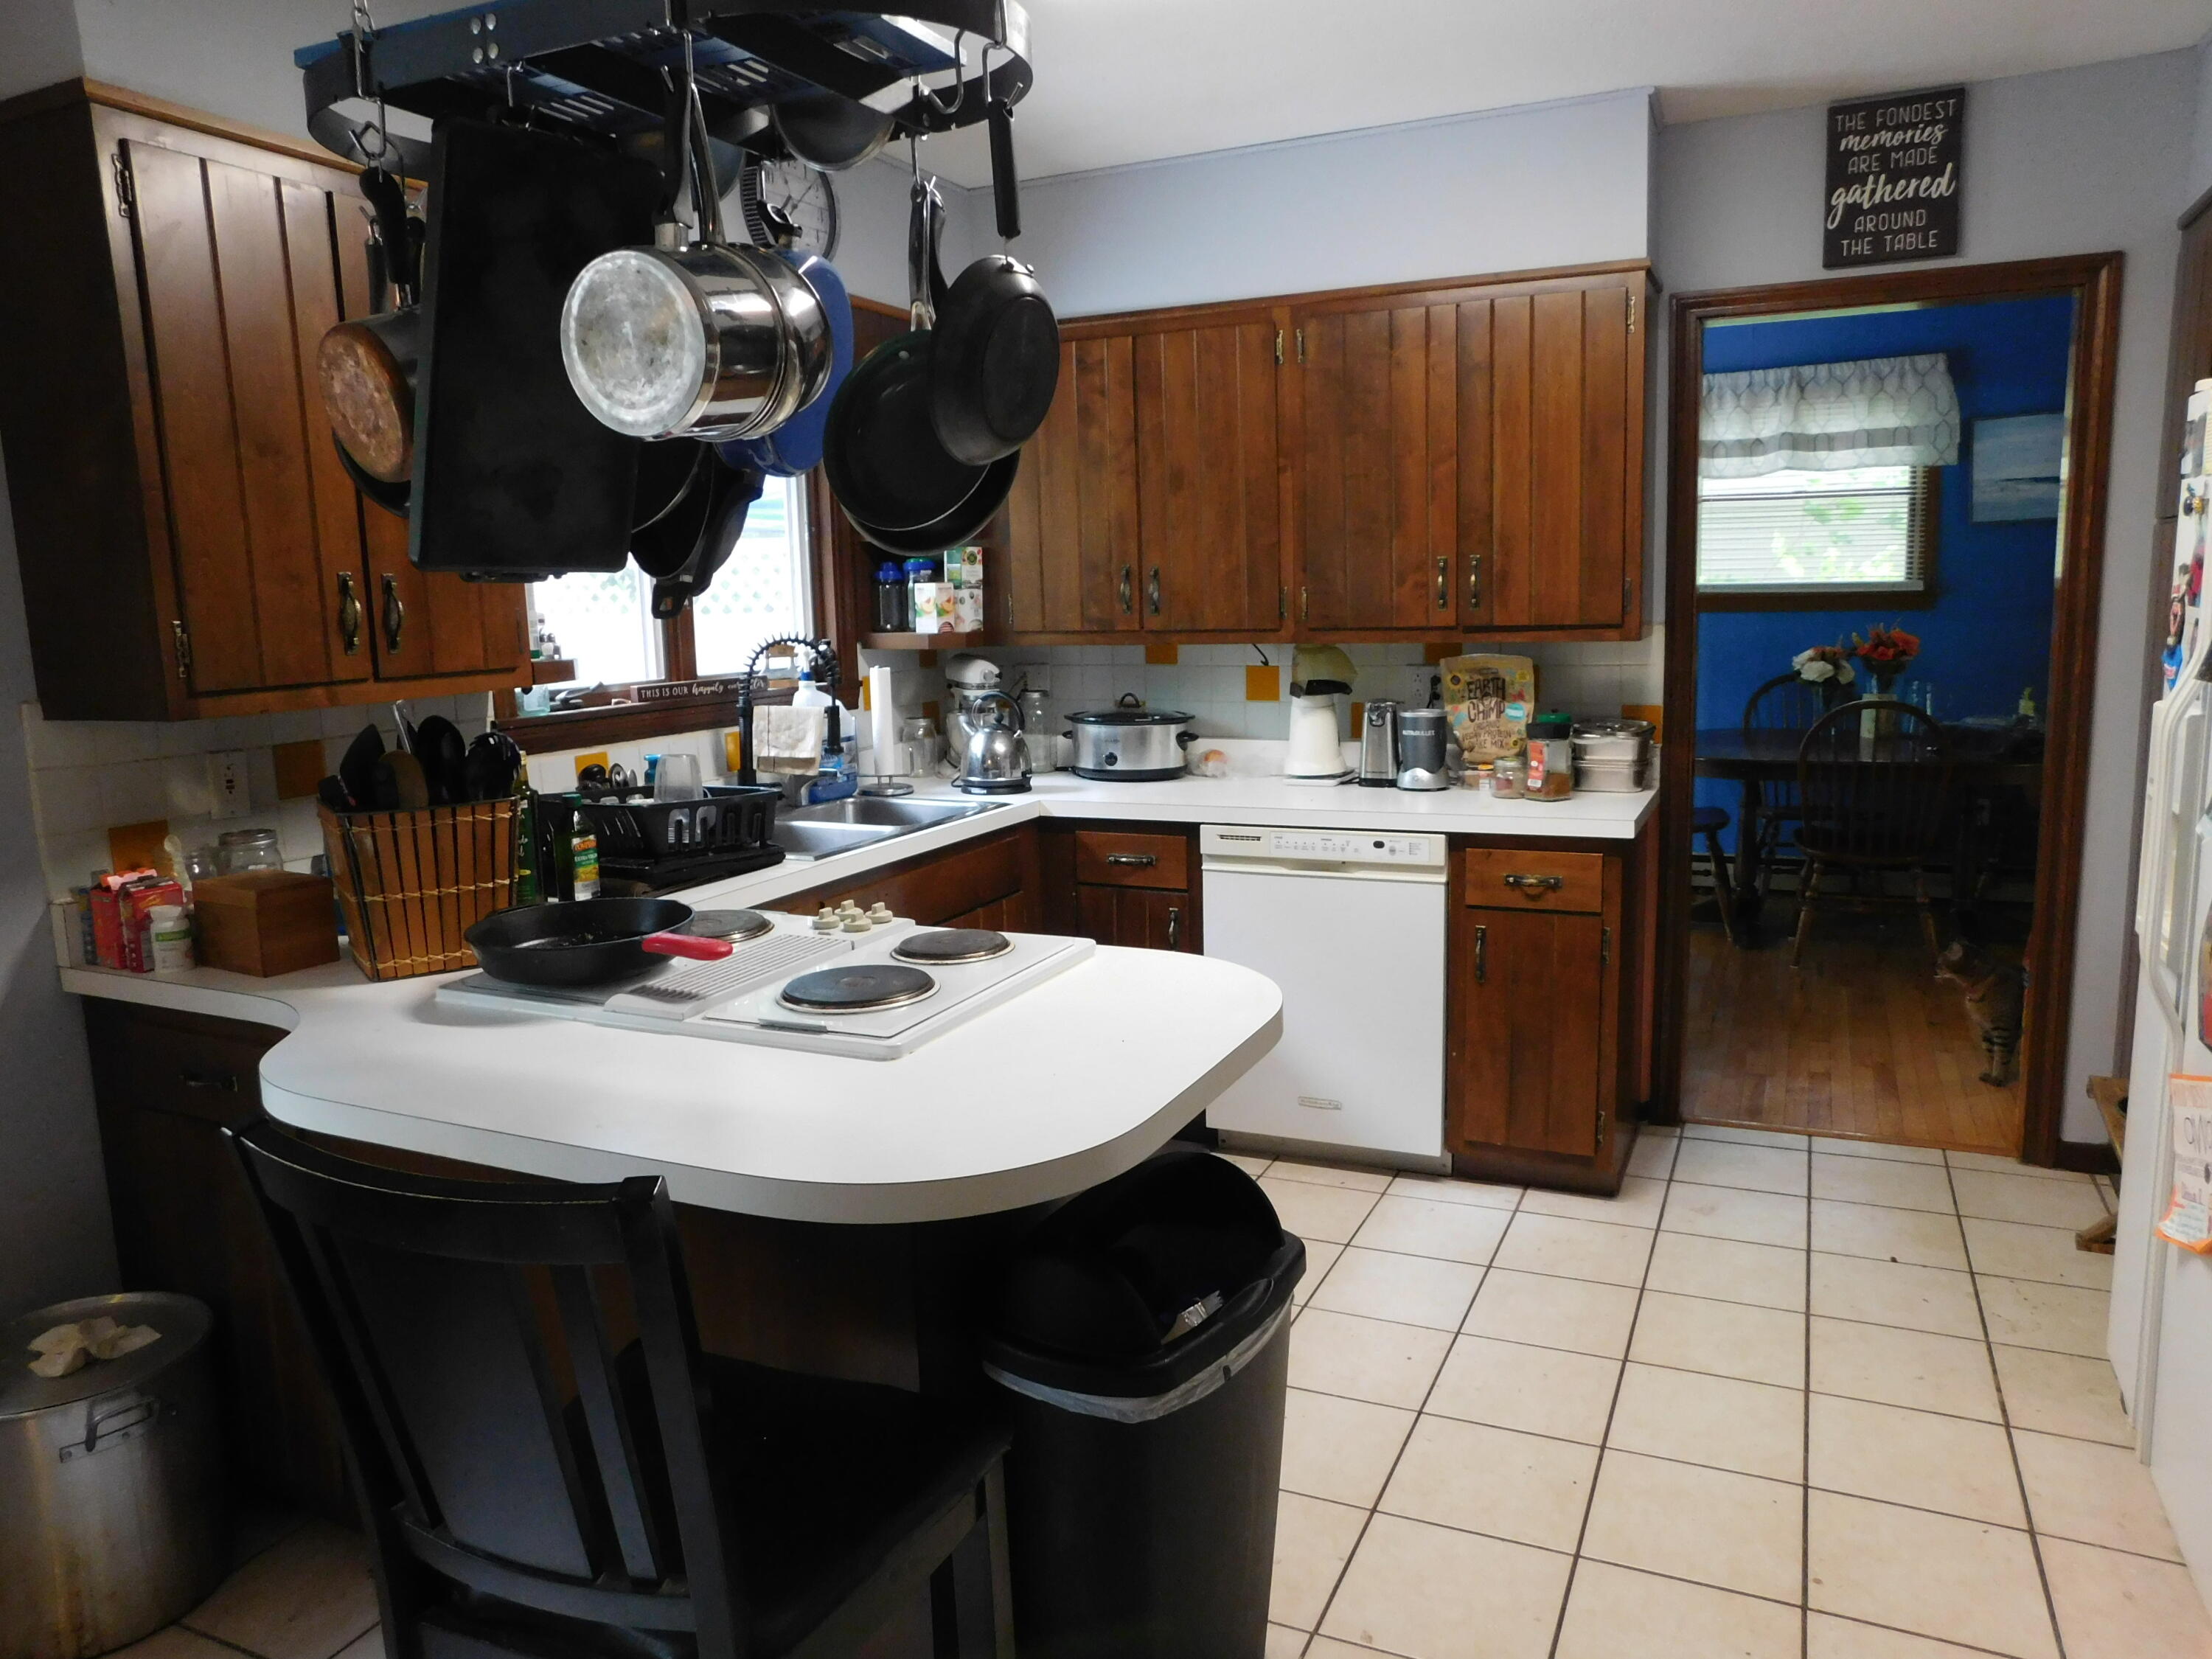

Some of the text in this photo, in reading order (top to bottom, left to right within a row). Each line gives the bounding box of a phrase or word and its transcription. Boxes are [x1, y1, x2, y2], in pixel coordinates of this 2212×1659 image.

[1835, 99, 1957, 132] THE FONDEST
[1839, 124, 1949, 152] memories
[1848, 147, 1938, 175] ARE MADE
[1827, 161, 1956, 229] gathered
[1854, 209, 1927, 234] AROUND
[1841, 229, 1939, 257] THE TABLE
[641, 687, 660, 699] THIS
[662, 686, 670, 698] IS
[672, 686, 689, 696] OUR
[1467, 677, 1506, 700] EARTH
[1467, 699, 1505, 723] CHIMP
